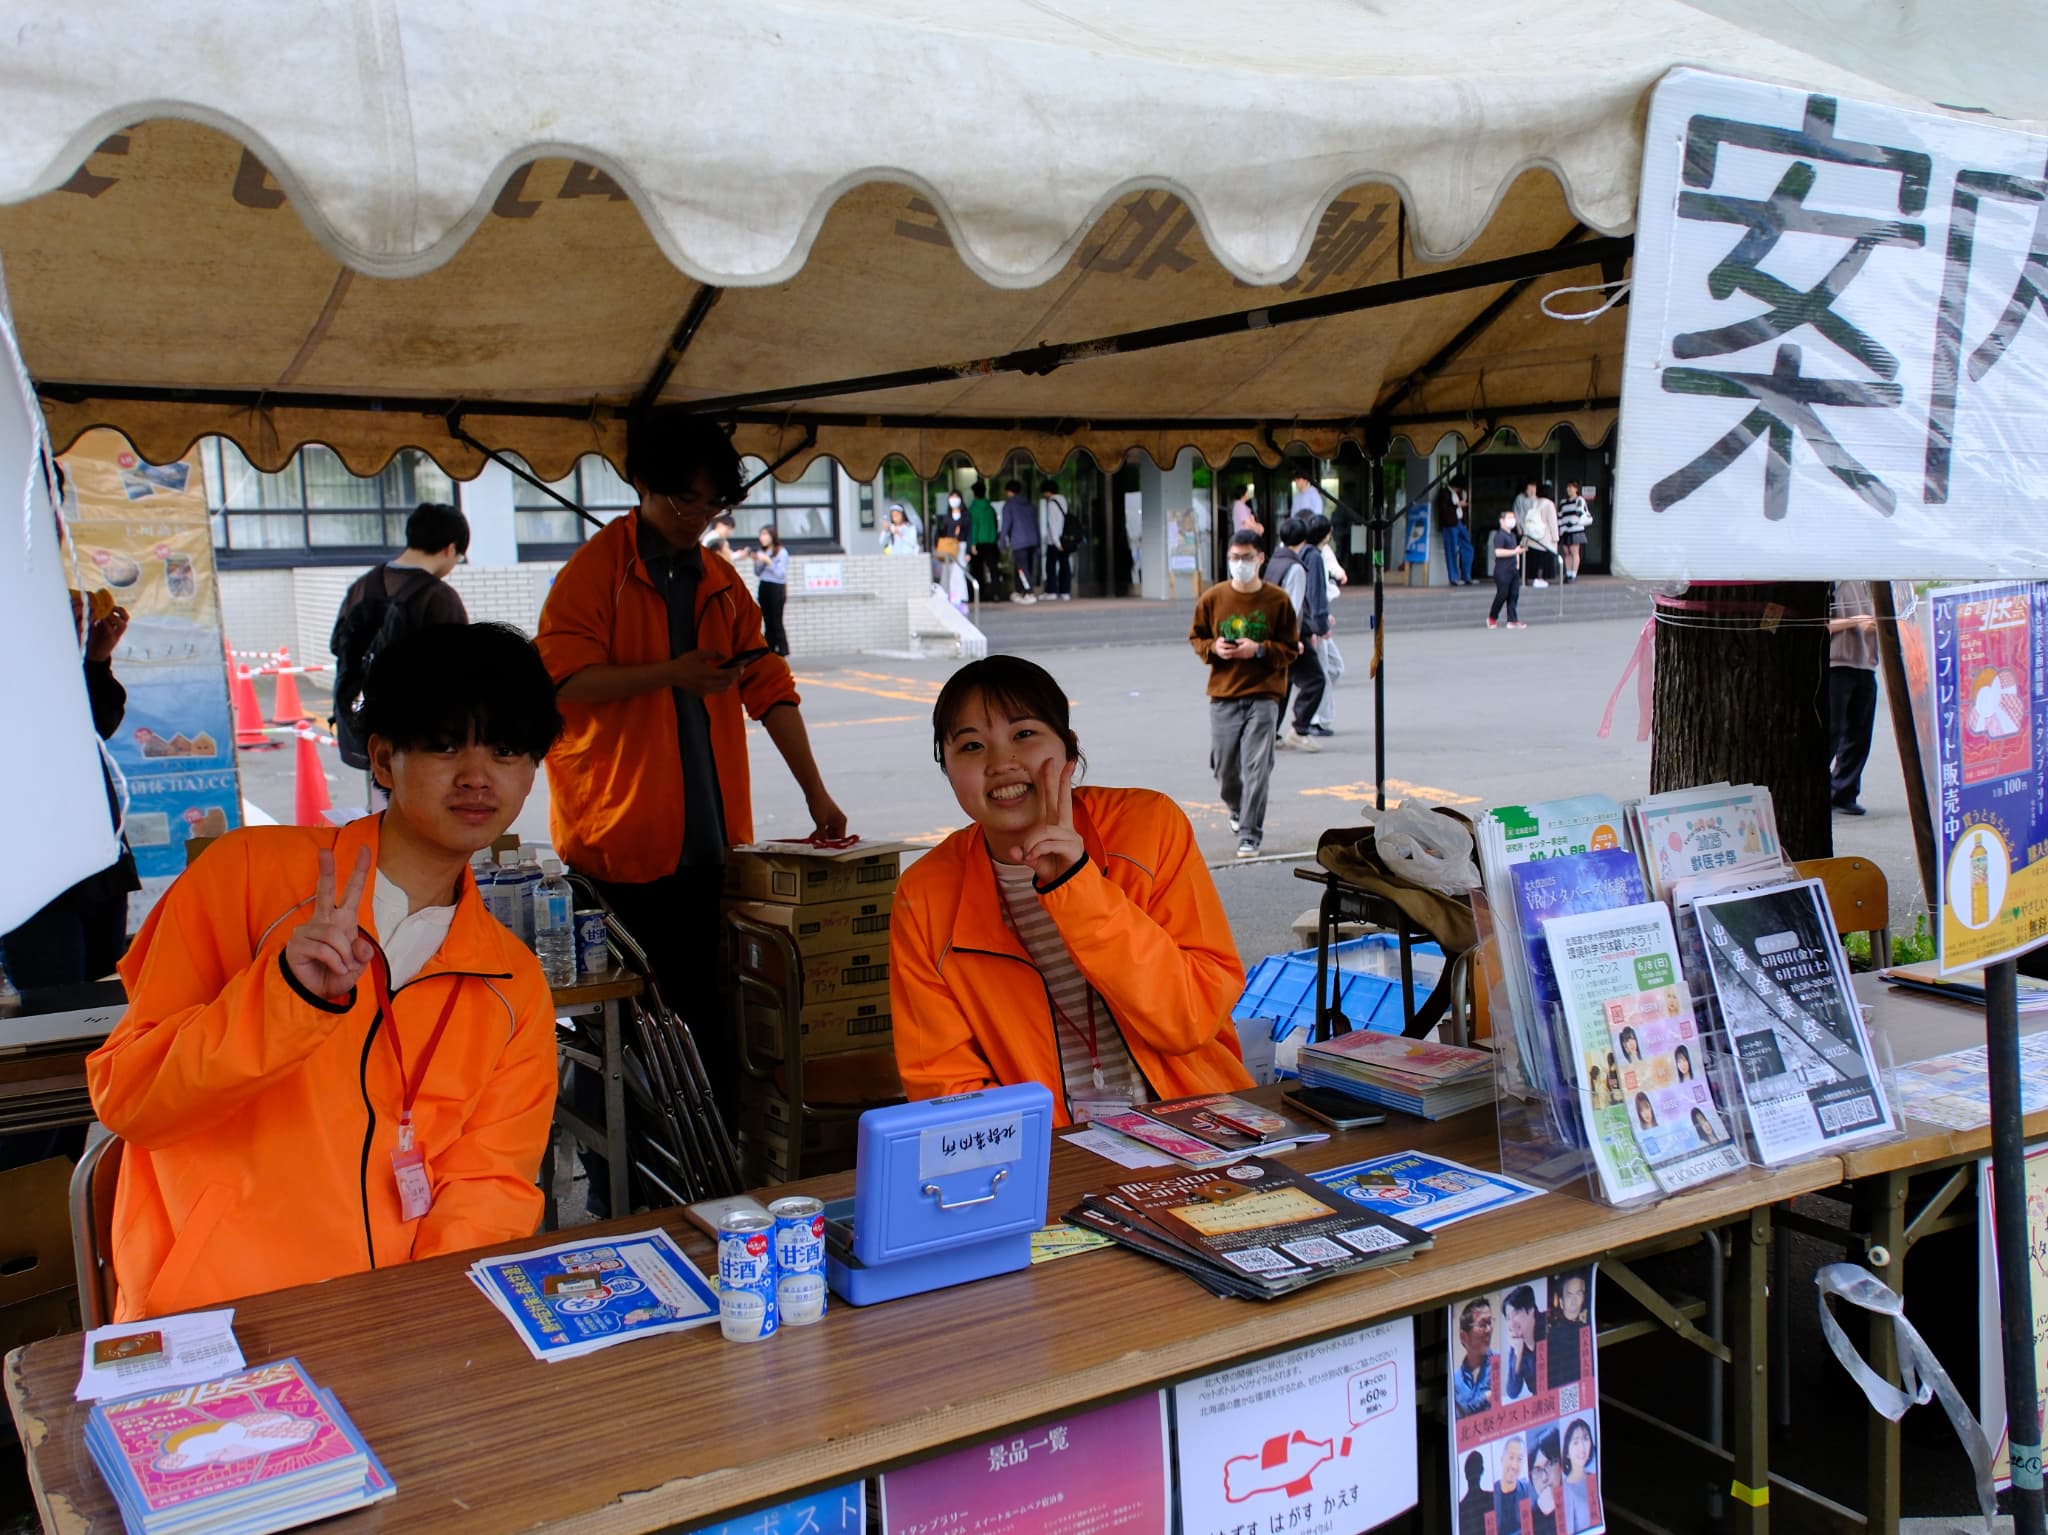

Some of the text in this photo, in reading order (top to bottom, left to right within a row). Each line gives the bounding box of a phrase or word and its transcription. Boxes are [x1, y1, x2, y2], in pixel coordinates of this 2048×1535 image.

[1690, 849, 1737, 872] 獣医学祭
[1823, 1045, 1849, 1060] 2025
[1118, 1172, 1220, 1196] Mission
[780, 1241, 821, 1265] 甘酒
[720, 1256, 758, 1280] 甘酒
[988, 1425, 1069, 1471] 景品一覧
[1324, 1484, 1360, 1516] かえす
[1270, 1502, 1313, 1534] はがす
